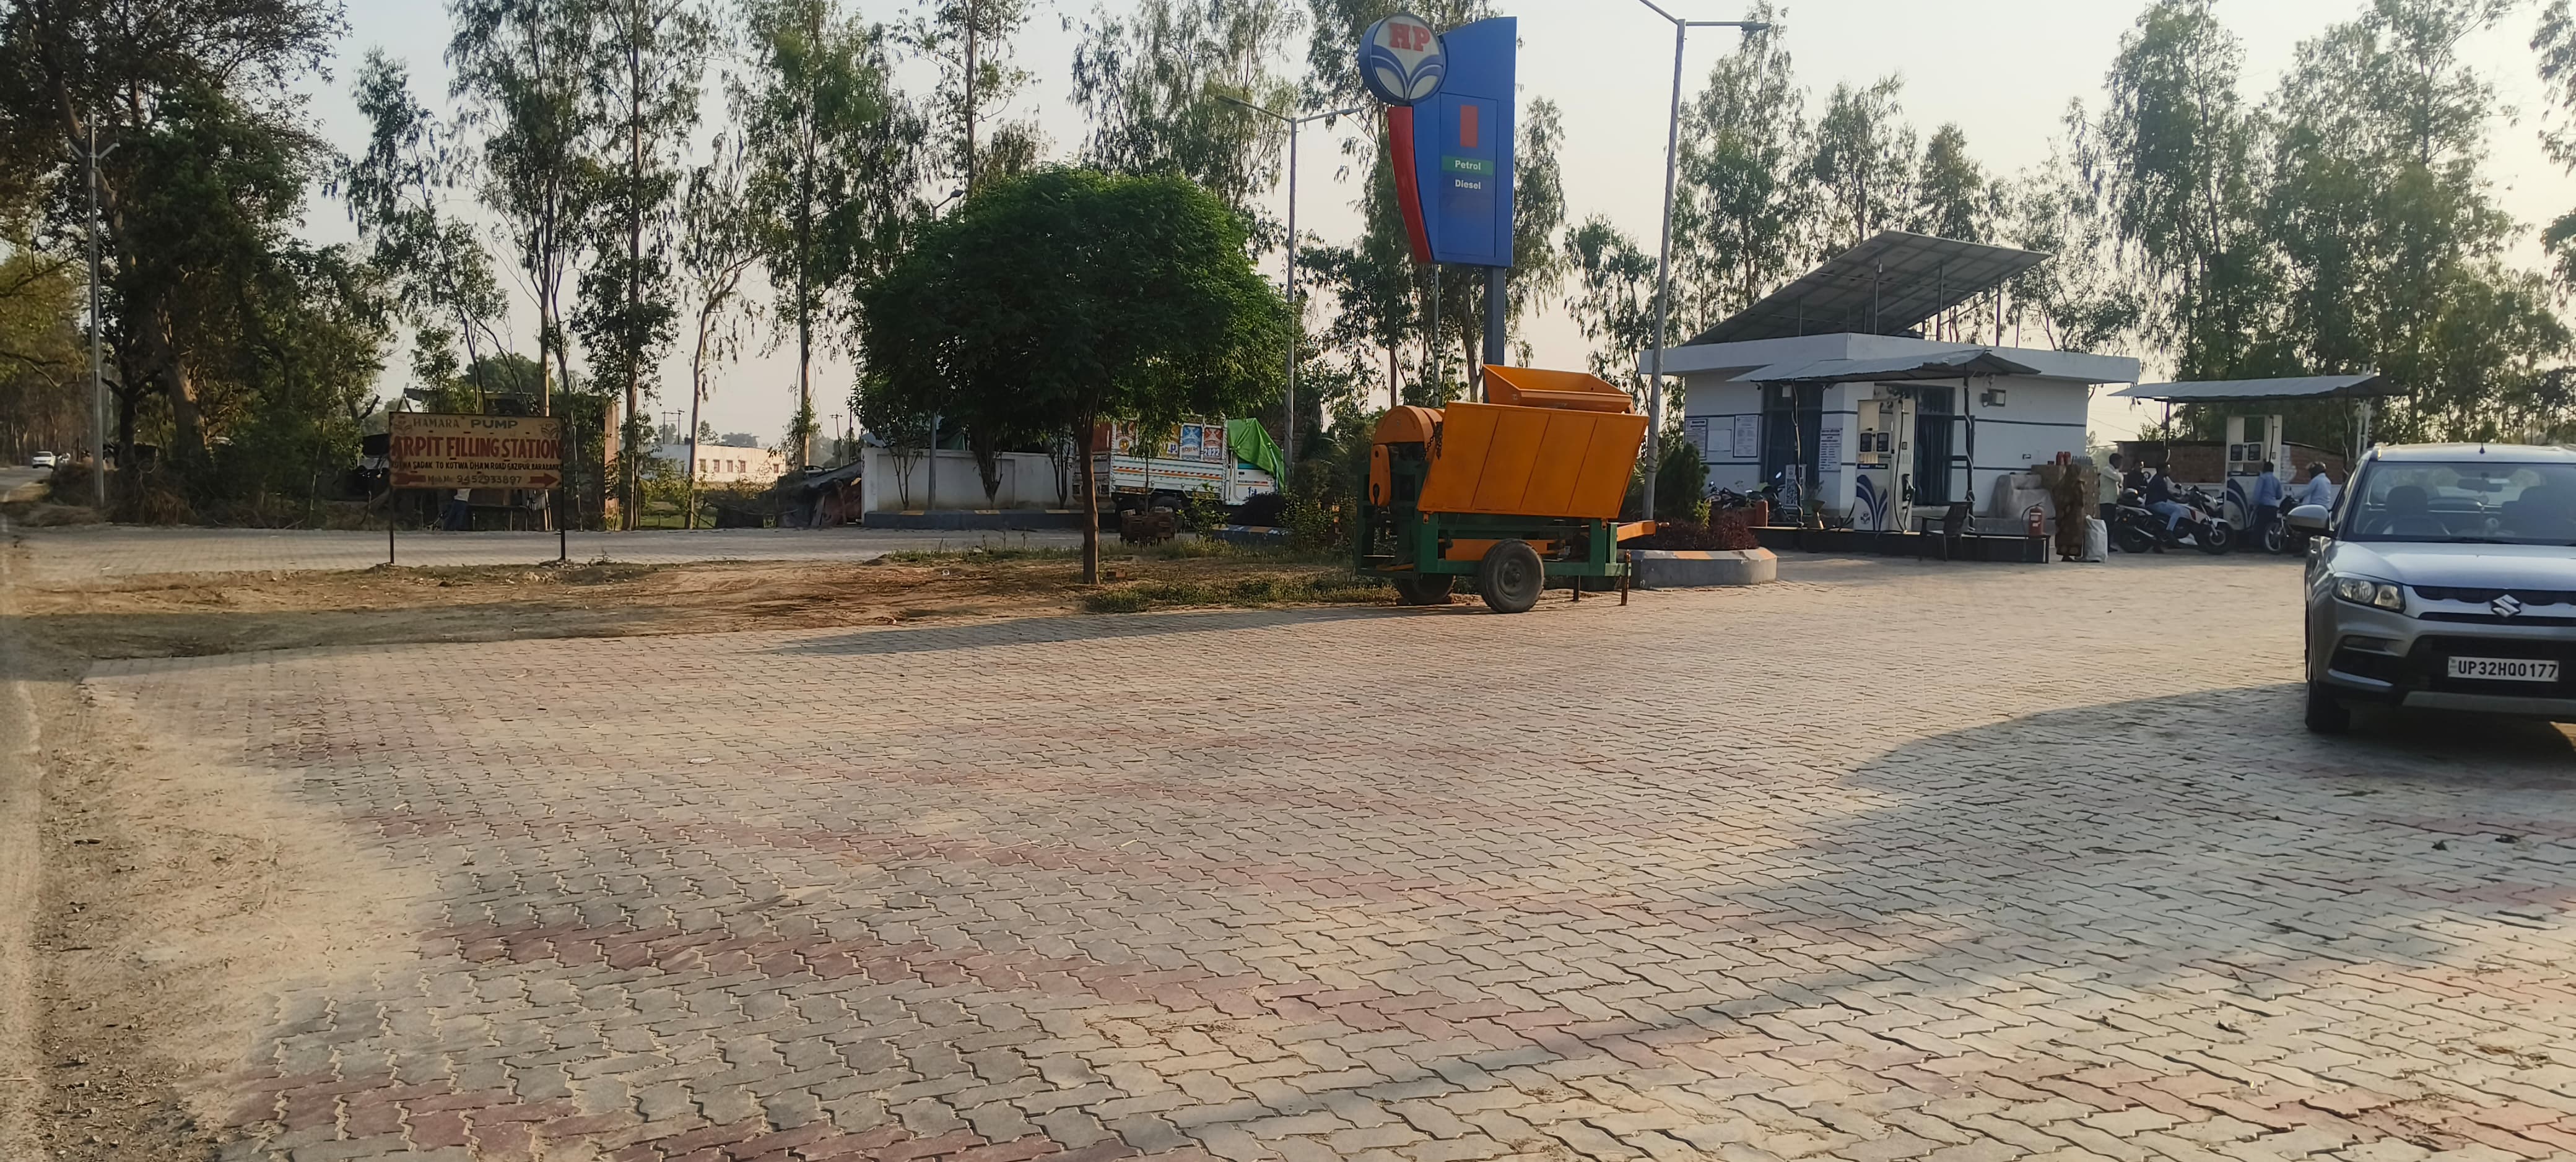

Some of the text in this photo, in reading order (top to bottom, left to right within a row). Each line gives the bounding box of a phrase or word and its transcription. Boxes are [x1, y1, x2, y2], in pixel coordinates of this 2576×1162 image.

[1388, 22, 1430, 51] HP
[1455, 159, 1481, 171] Petrol
[1455, 178, 1481, 190] Diesel
[413, 417, 518, 428] HAMARA PUMP
[391, 435, 564, 459] ARPIT FILLING STATION
[1204, 448, 1220, 456] 2022
[412, 461, 432, 470] SADAK
[436, 461, 444, 469] TO
[445, 461, 468, 469] KOTWA
[470, 462, 490, 470] DHAM
[2458, 660, 2557, 679] UP32HQ0177
